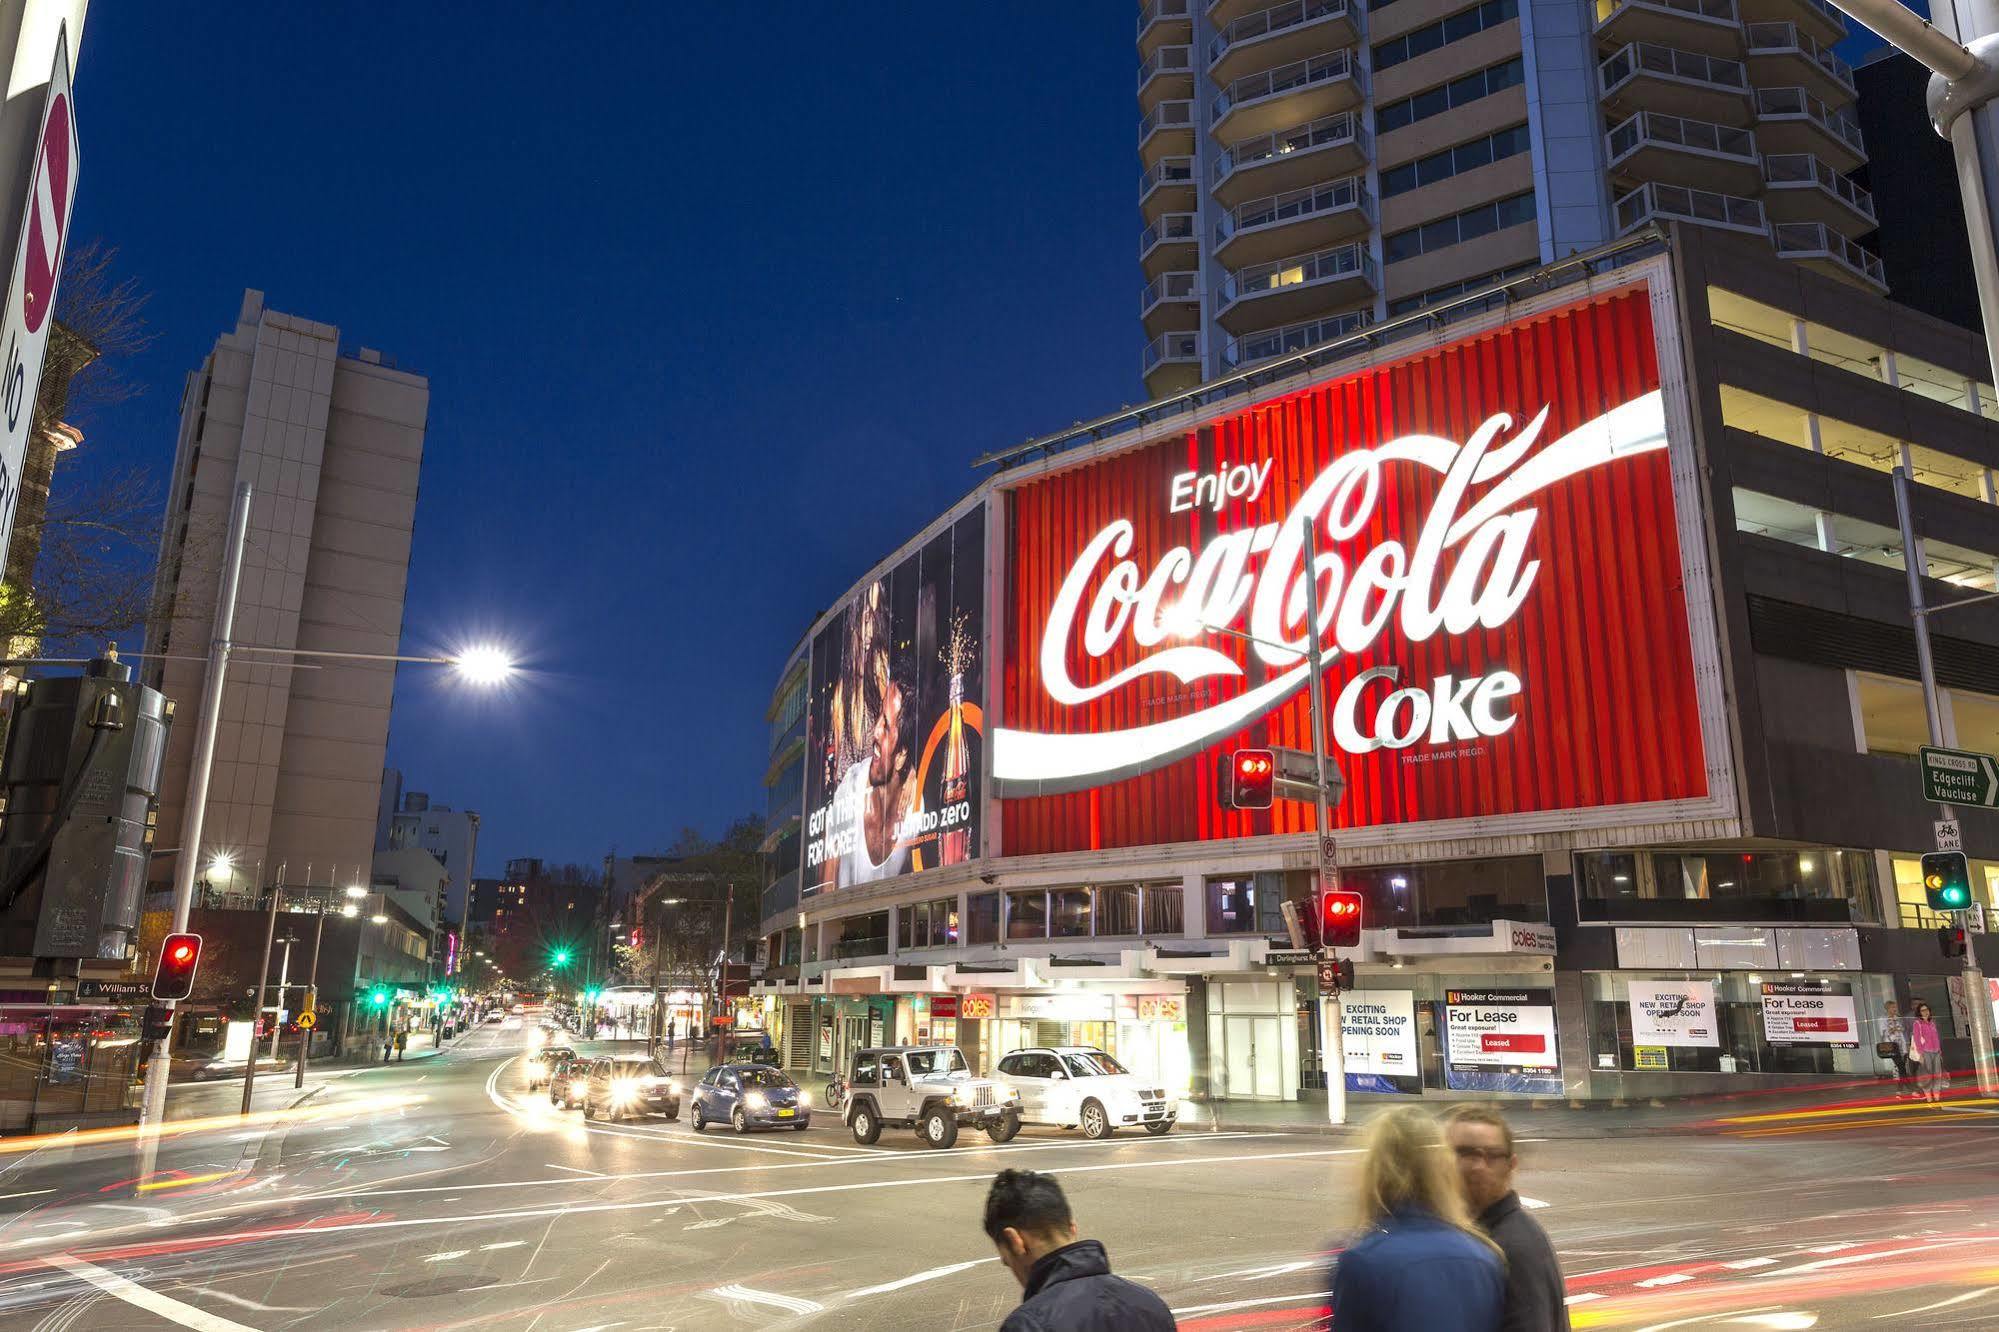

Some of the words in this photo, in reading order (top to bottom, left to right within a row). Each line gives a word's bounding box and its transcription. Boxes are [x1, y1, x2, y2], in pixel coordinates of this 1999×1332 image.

[1170, 456, 1273, 514] Enjoy
[1041, 401, 1543, 705] Coca-Cola
[1332, 665, 1521, 754] Coke
[1402, 753, 1430, 764] TRADE
[1431, 750, 1457, 760] MARK
[1928, 754, 1946, 766] KINGS
[1947, 758, 1966, 769] CROSS
[1967, 761, 1976, 769] RD
[1932, 770, 1976, 787] Edgecliff
[1934, 785, 1977, 801] Vaucluse
[940, 801, 970, 827] zero
[809, 807, 826, 837] GOT
[1938, 839, 1960, 849] LANE
[808, 839, 824, 868] FOR
[1512, 928, 1537, 947] coles
[1309, 953, 1317, 961] Rd
[99, 983, 136, 993] William
[139, 984, 149, 993] St
[1461, 993, 1486, 1001] Hooker
[1487, 993, 1528, 1001] Commercial
[1764, 998, 1784, 1008] For
[1787, 998, 1824, 1009] Lease
[962, 998, 990, 1017] coles
[1346, 1005, 1386, 1014] EXCITING
[1639, 1001, 1656, 1009] NEW
[1449, 1009, 1471, 1022] For
[1475, 1009, 1518, 1022] Lease
[1680, 1009, 1701, 1017] SOON
[1351, 1016, 1380, 1025] RETAIL
[1383, 1016, 1407, 1025] SHOP
[1341, 1027, 1373, 1036] PENING
[1375, 1027, 1400, 1036] SOON
